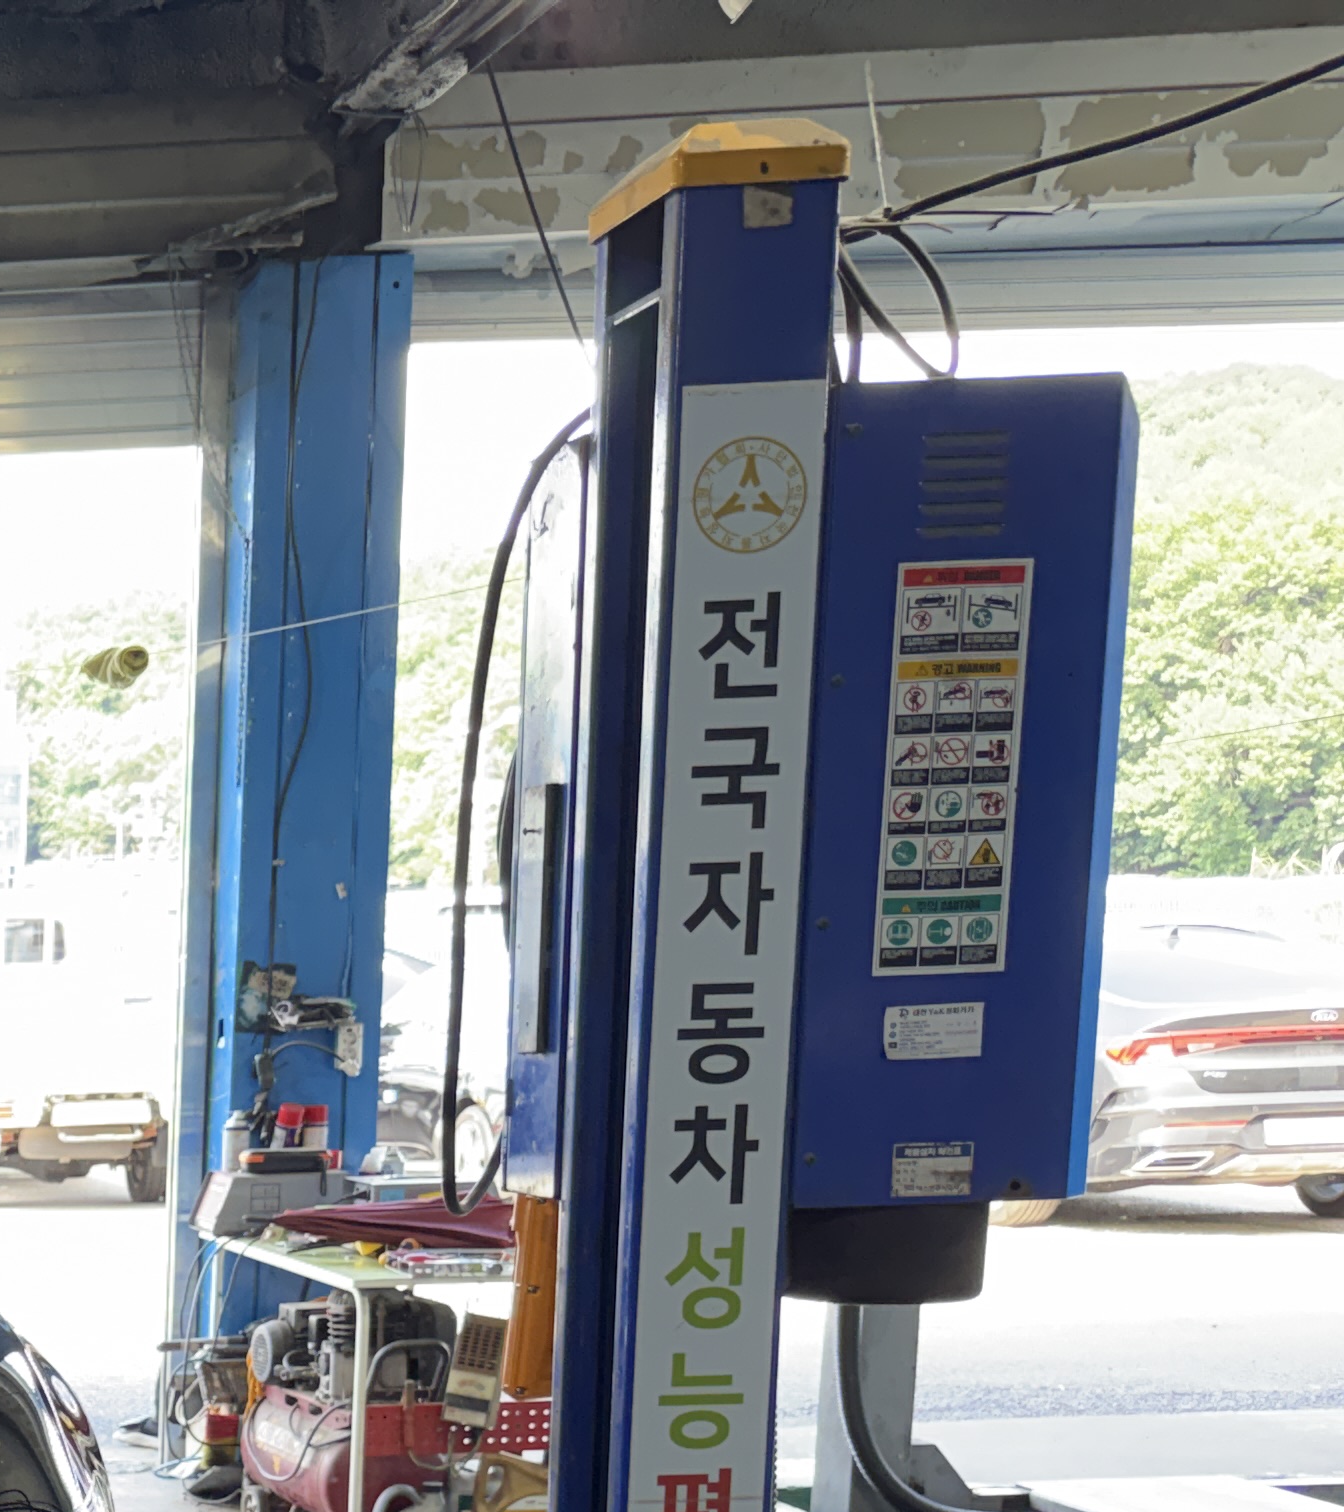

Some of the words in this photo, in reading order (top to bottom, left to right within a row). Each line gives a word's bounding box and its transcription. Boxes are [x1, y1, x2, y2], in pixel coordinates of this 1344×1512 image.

[931, 663, 954, 675] 경고
[957, 662, 1002, 674] WARNING
[940, 899, 981, 911] CAUTION
